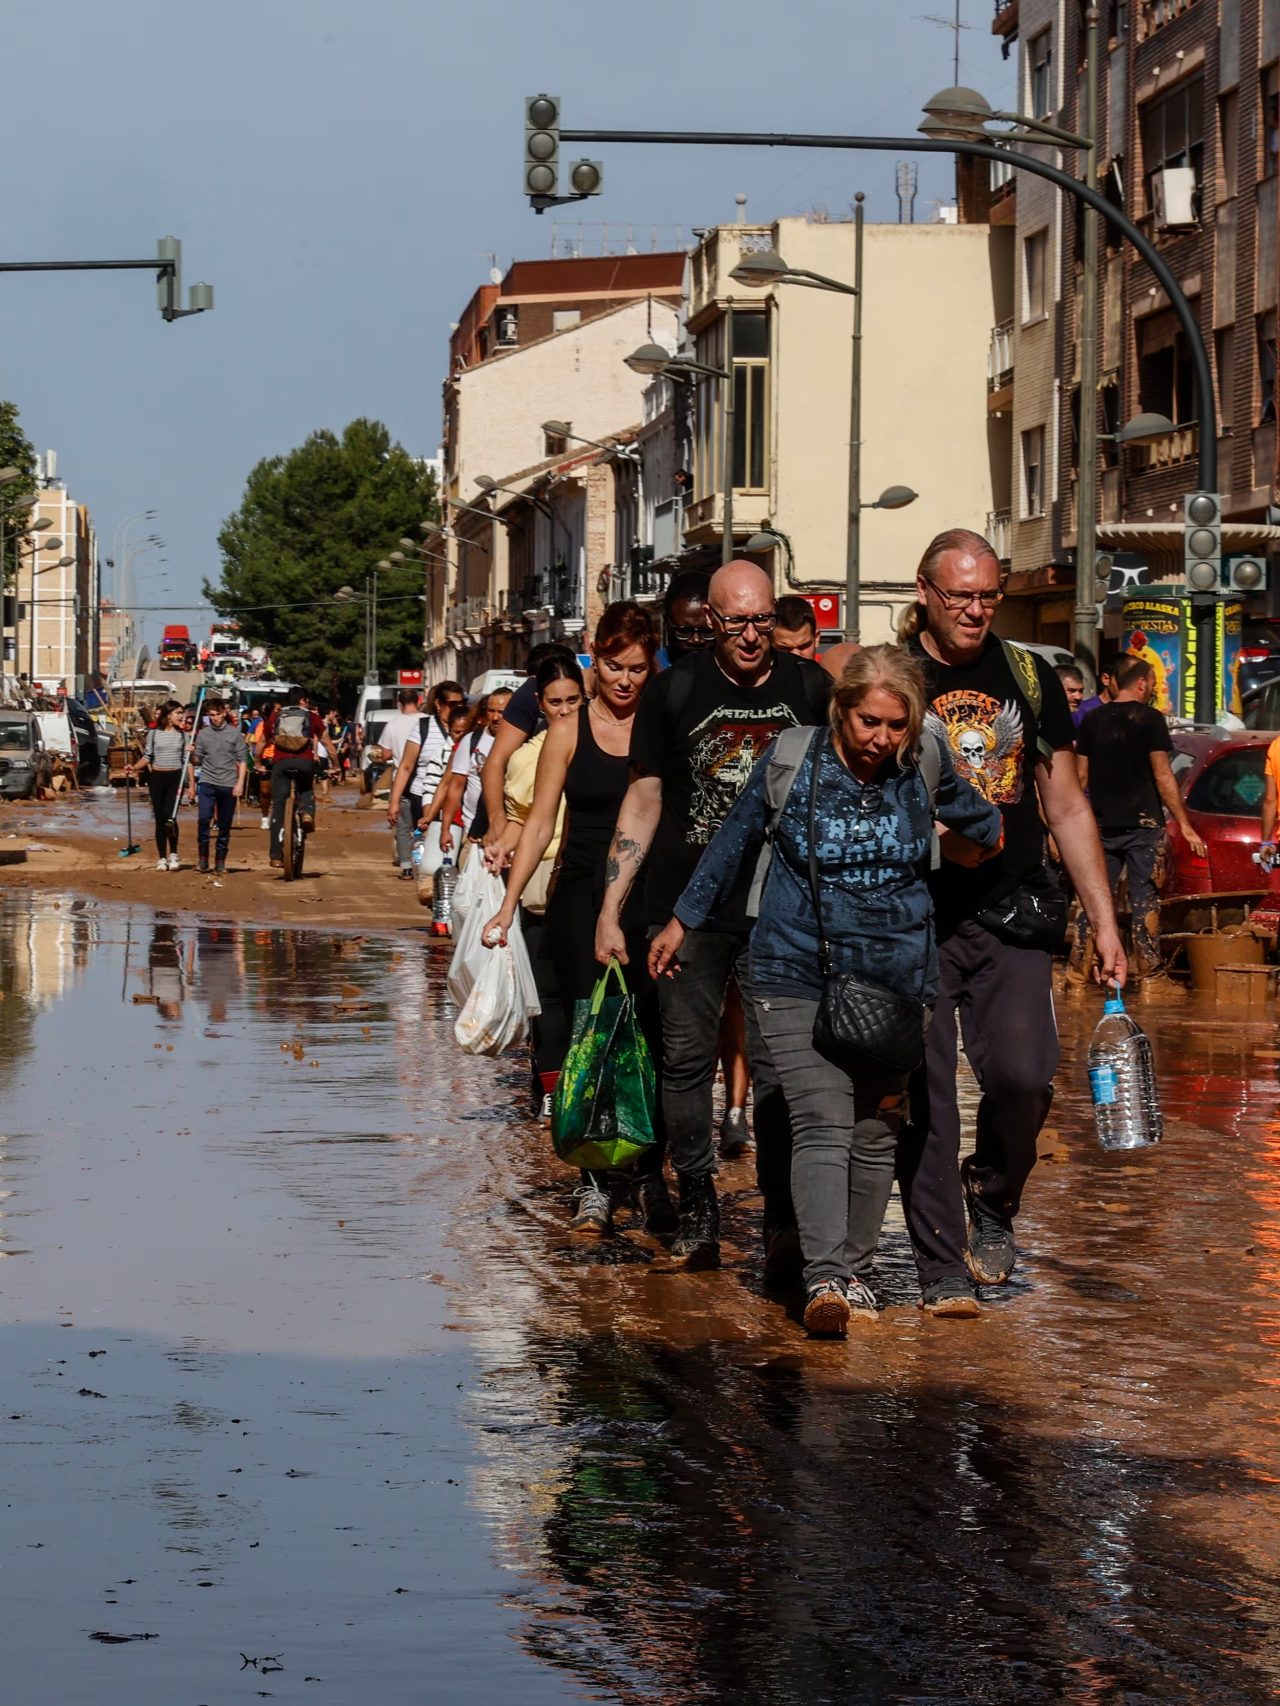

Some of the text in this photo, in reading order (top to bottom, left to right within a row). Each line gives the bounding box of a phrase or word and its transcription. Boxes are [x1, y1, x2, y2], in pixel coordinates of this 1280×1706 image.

[1145, 601, 1180, 616] ALASKA
[931, 689, 1002, 717] ROCK
[688, 702, 803, 736] METALLICA
